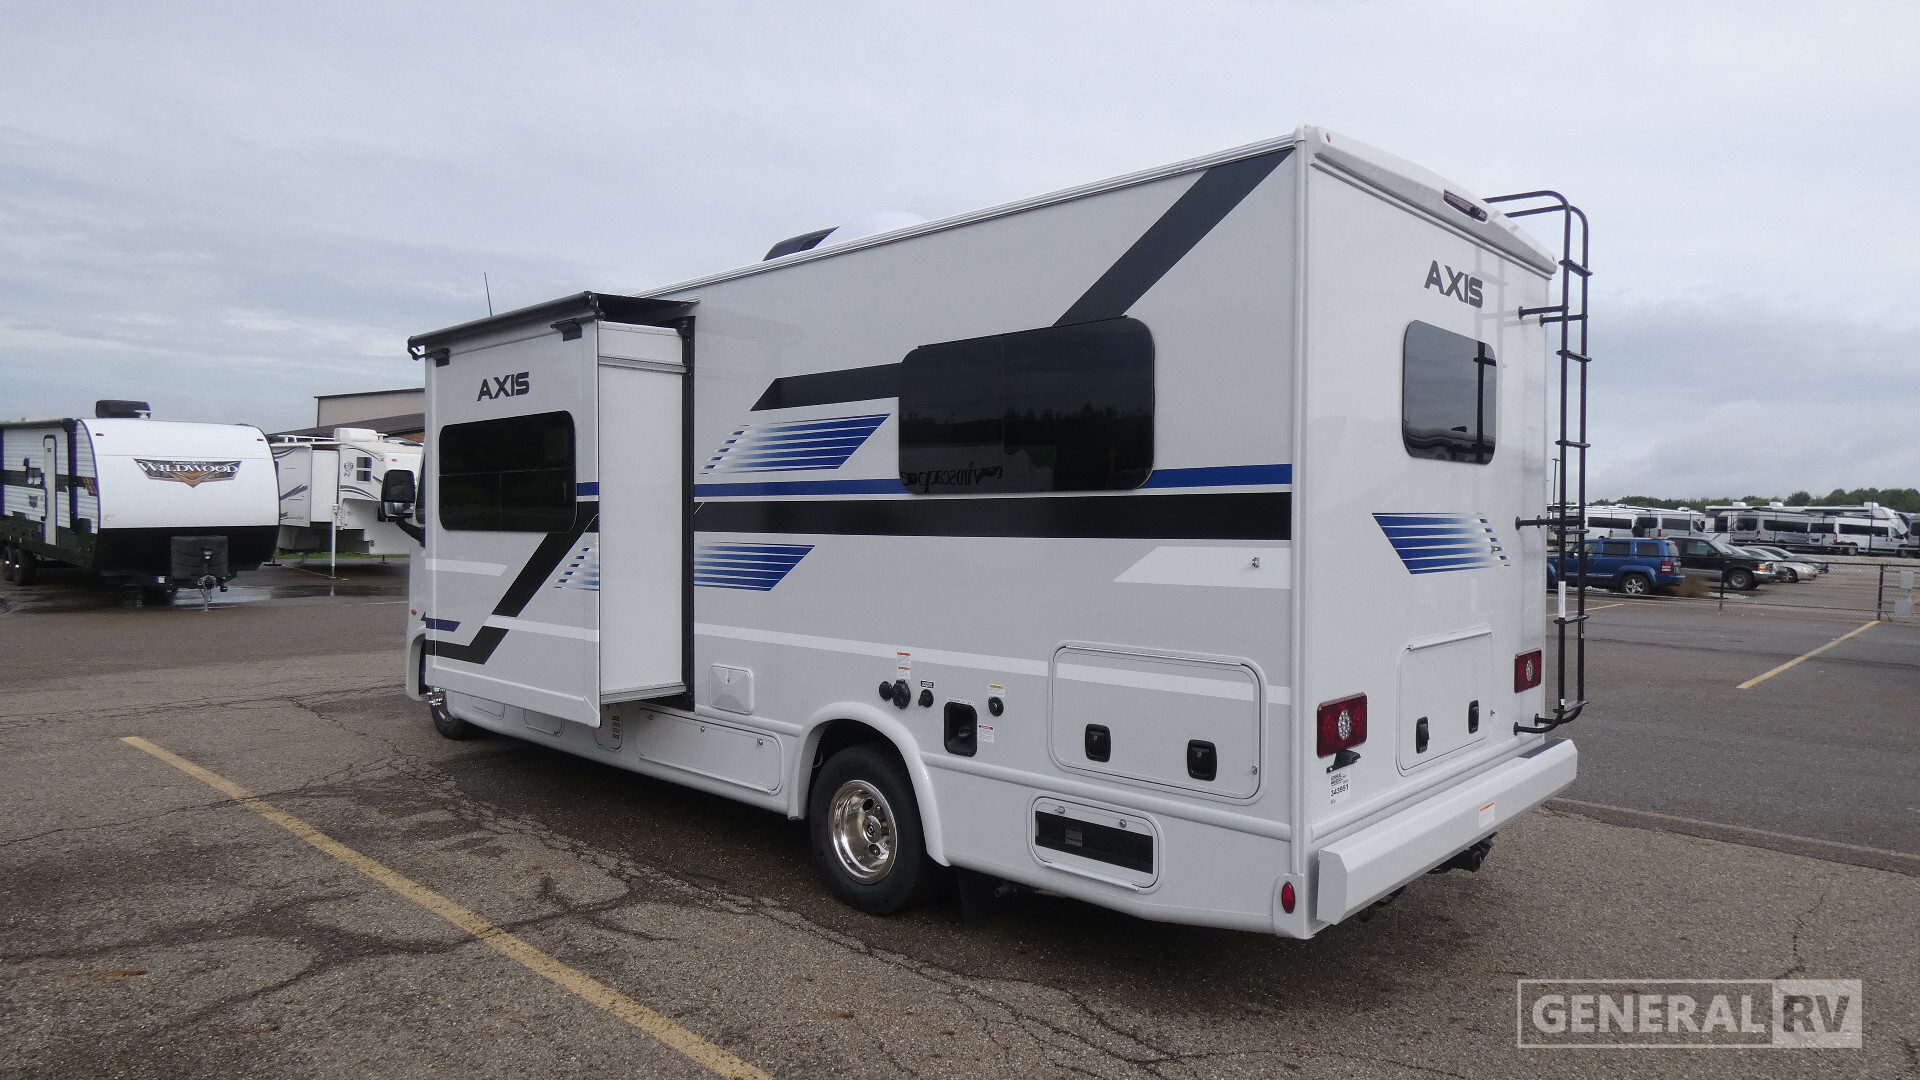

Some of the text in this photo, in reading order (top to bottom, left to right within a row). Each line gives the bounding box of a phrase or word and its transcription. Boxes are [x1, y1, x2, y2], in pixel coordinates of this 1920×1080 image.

[1423, 259, 1482, 308] AXIS
[477, 371, 529, 401] AXIS
[138, 463, 238, 472] WILDWOOD
